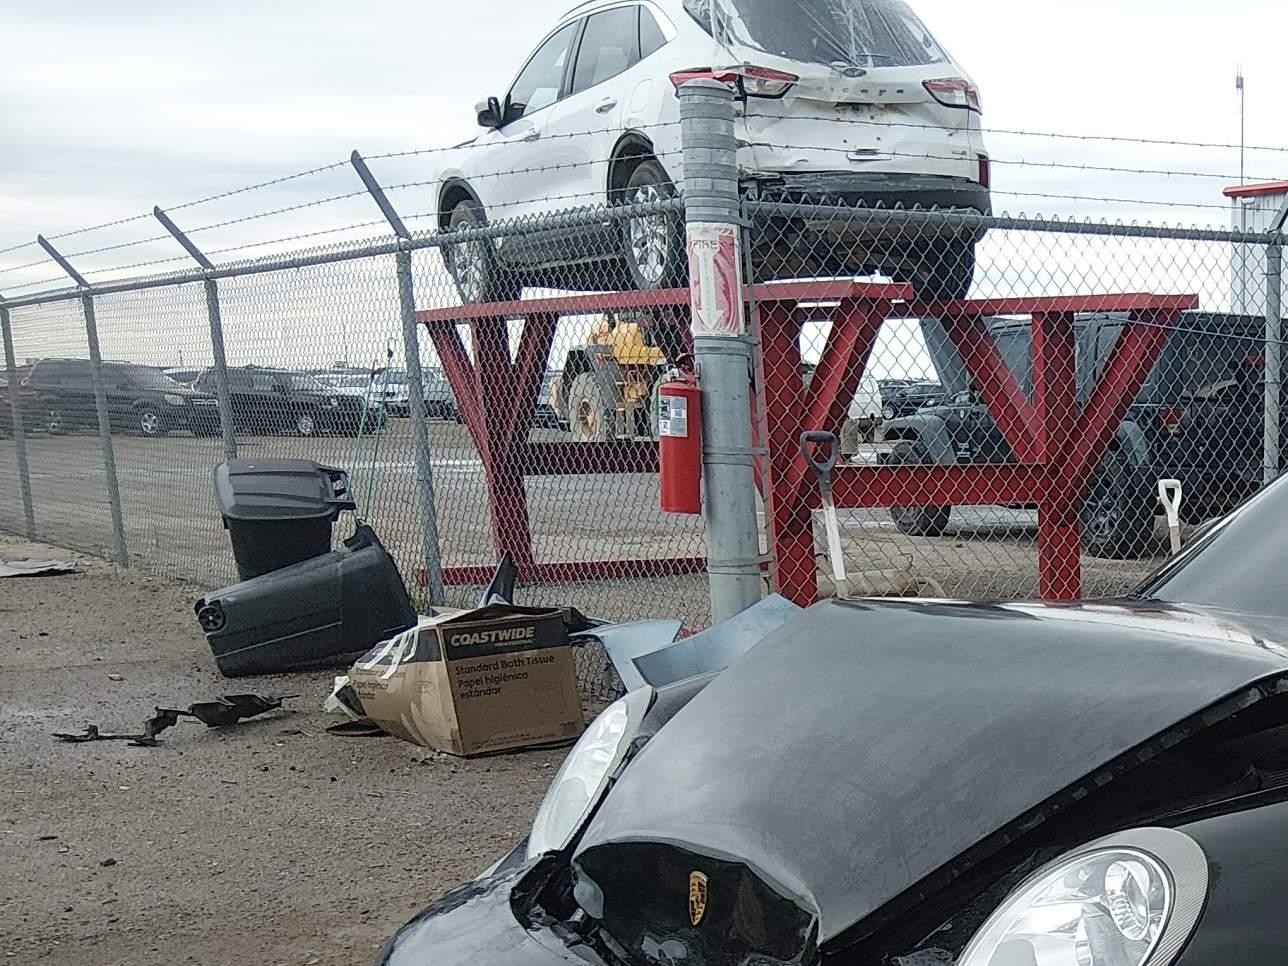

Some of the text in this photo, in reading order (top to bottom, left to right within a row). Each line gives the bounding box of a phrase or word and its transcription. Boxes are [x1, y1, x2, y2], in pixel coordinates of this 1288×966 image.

[450, 626, 536, 647] COASTWIDE
[455, 655, 555, 676] Standard Bath Tissue
[457, 676, 484, 689] Papel
